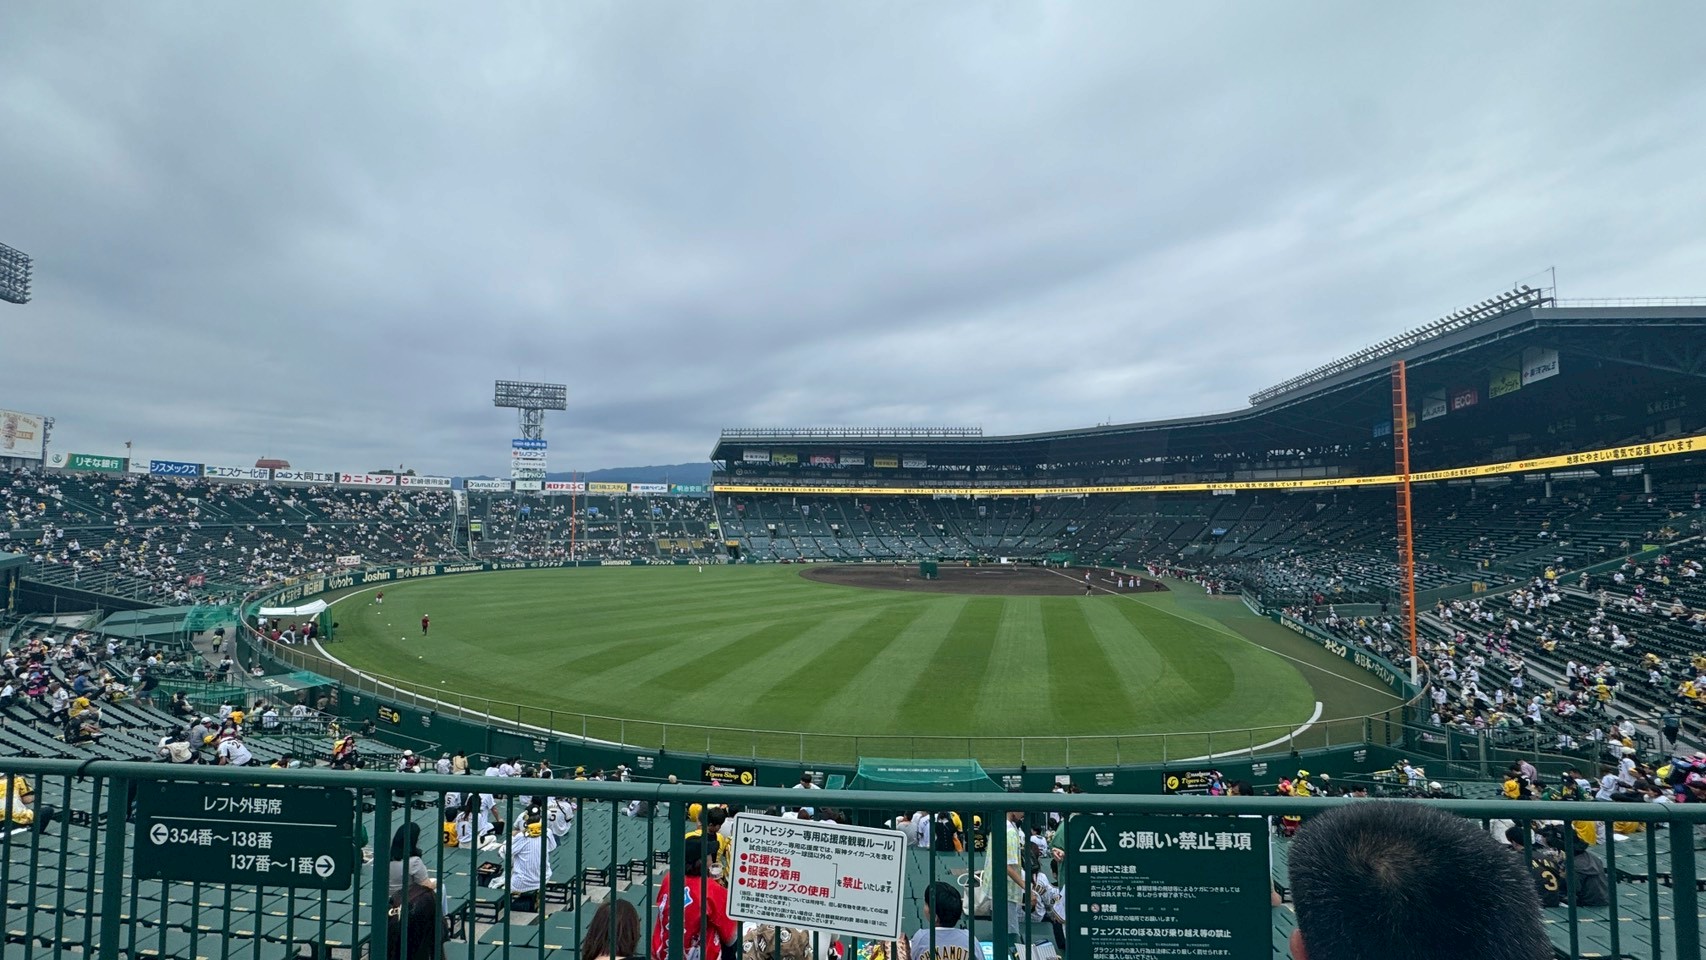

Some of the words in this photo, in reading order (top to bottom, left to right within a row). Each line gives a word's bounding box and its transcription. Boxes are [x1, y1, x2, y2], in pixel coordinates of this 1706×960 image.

[1455, 393, 1471, 408] ECC
[1567, 439, 1694, 464] 地球にやさしい電気で応援しています
[76, 457, 119, 469] りそな銀行
[151, 463, 197, 474] シスメックス
[218, 467, 268, 478] エスケー化研
[293, 472, 334, 482] 大同工業
[342, 474, 395, 484] カニトップ
[410, 478, 450, 486] 尼崎信用金庫
[362, 571, 391, 583] Joshin
[404, 566, 437, 578] 小野薬品
[329, 575, 354, 589] Kubota
[705, 770, 723, 778] Tigers
[724, 771, 739, 780] Shop
[204, 796, 282, 815] レフト外野席
[743, 822, 896, 852] 【レフトビジター専用応援席観戦ルール】
[1118, 831, 1252, 850] お願い・禁止事項
[748, 853, 792, 868] 応援行為
[747, 866, 801, 882] 服装の着用
[1090, 864, 1137, 874] 飛球にご注意
[1541, 870, 1558, 891] 3
[746, 877, 830, 899] 応援グッズの使用
[1101, 904, 1118, 913] 禁煙
[1091, 928, 1232, 938] フェンスにのぼる及び乗り越え等の禁止
